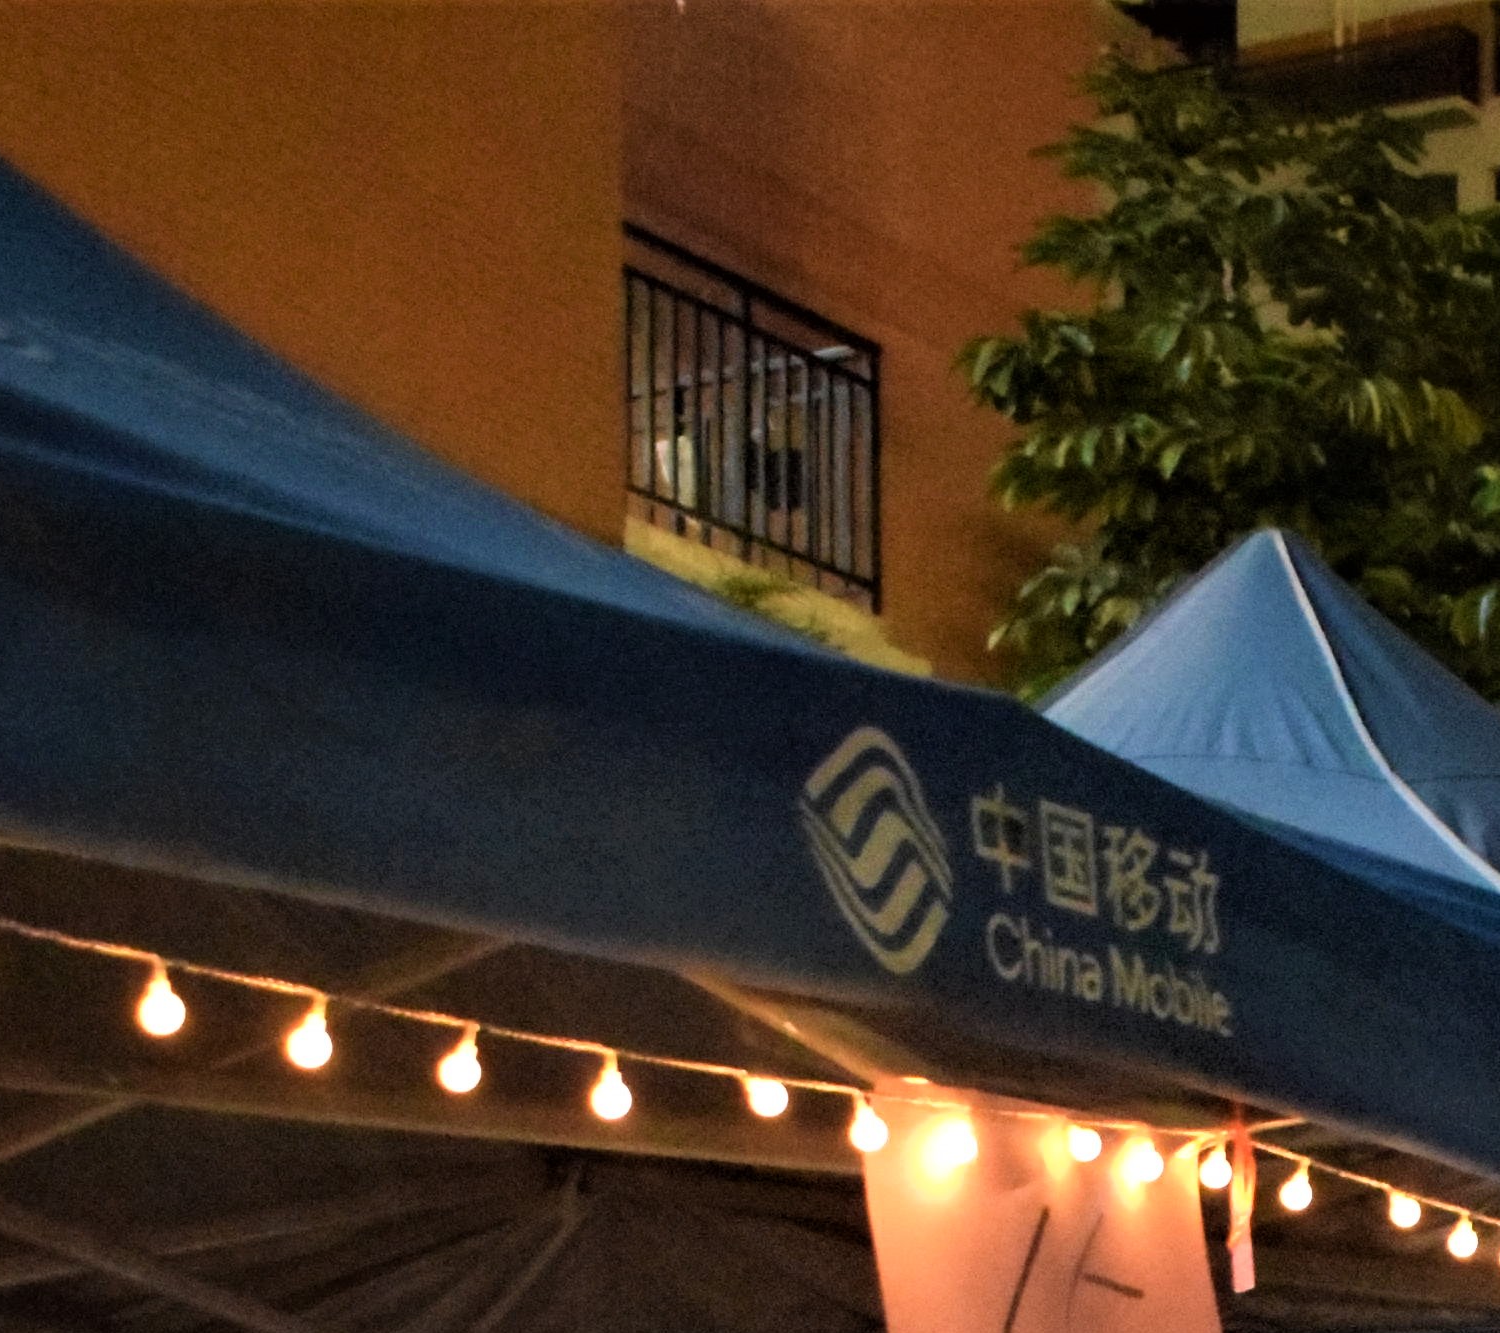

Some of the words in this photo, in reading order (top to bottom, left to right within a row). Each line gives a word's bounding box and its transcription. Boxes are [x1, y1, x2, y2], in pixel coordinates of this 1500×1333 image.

[970, 781, 1220, 953] 中国移动
[987, 913, 1102, 1001] China
[1109, 944, 1235, 1037] Mobile
